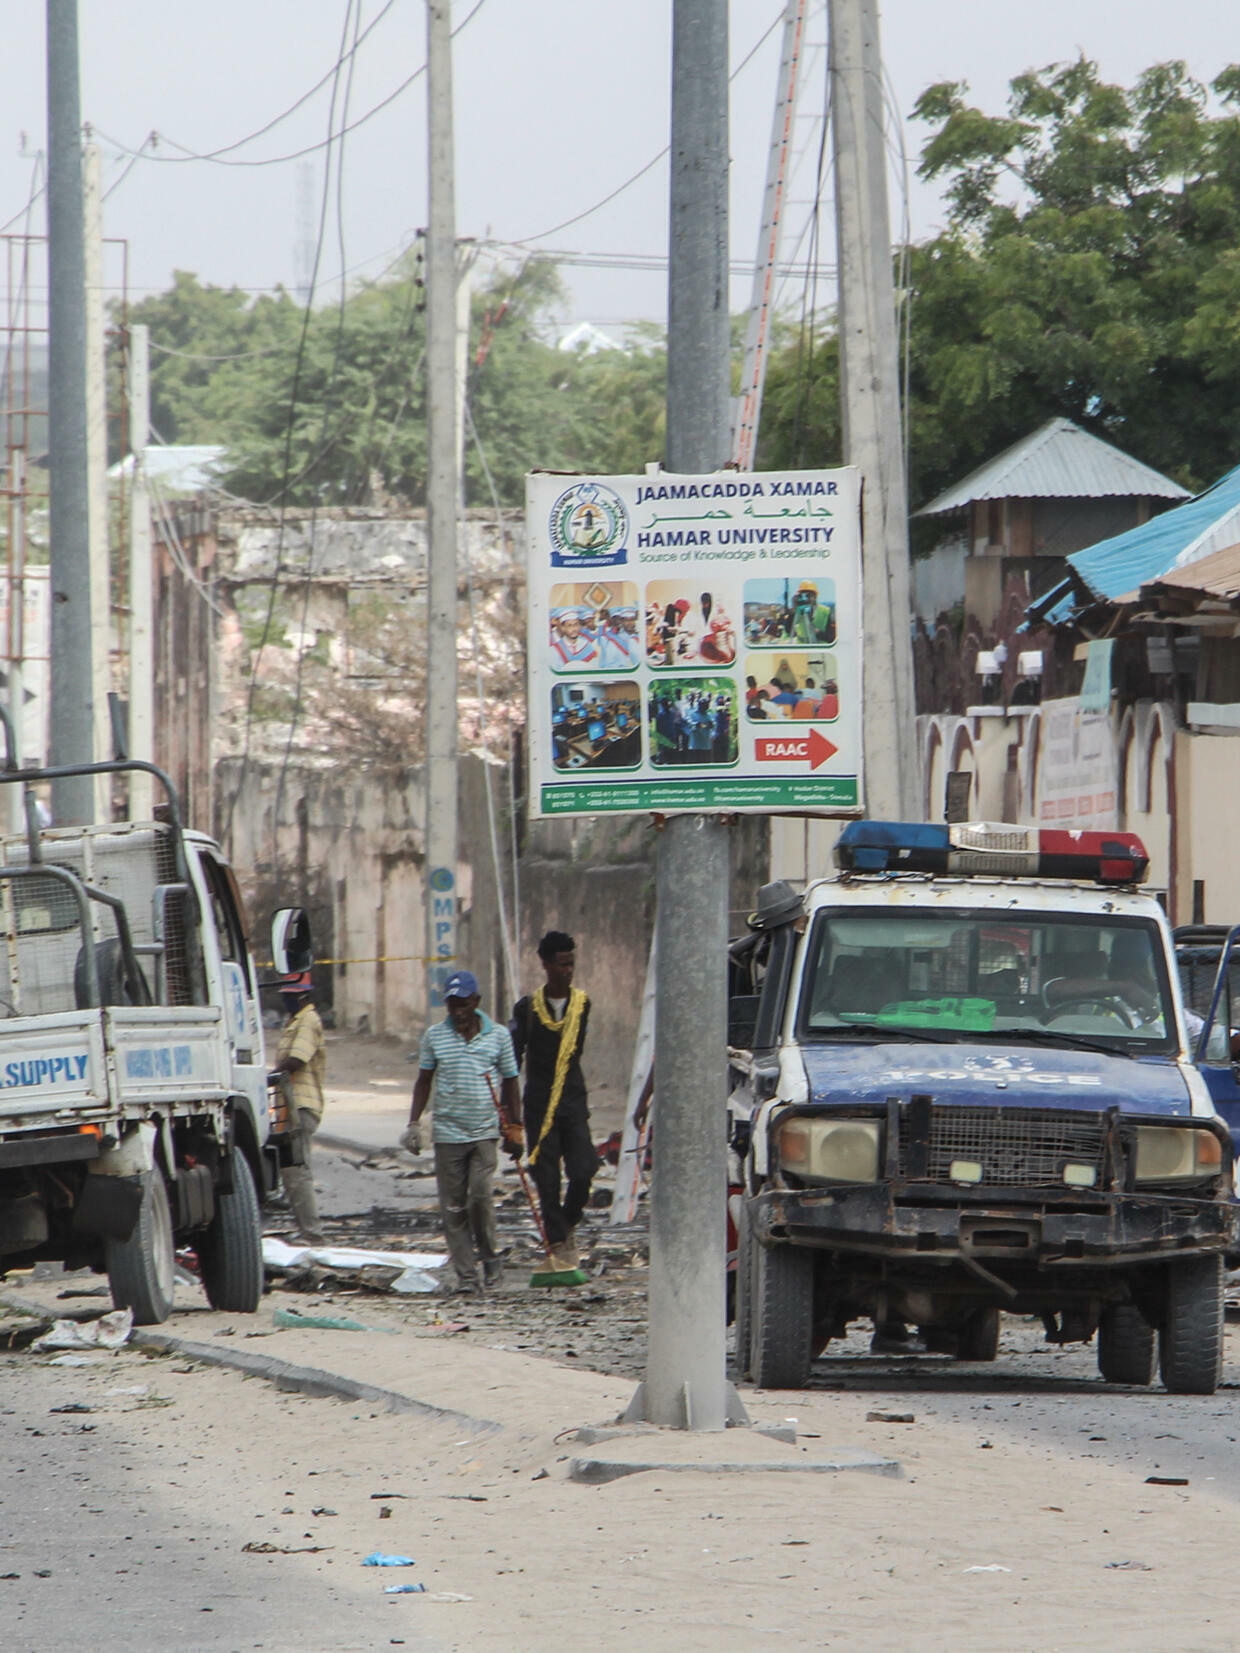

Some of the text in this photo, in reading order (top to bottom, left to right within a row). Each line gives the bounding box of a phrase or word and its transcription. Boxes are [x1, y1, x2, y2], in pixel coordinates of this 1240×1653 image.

[636, 481, 839, 505] JAAMACADDA XAMAR
[641, 509, 733, 529] حمر
[743, 498, 834, 522] جامعة
[637, 527, 835, 548] HAMAR UNIVERSITY
[639, 552, 677, 563] Source
[680, 550, 692, 561] of
[765, 742, 808, 756] RAAC
[5, 1054, 89, 1088] SUPPLY
[883, 1071, 1102, 1086] POLICE
